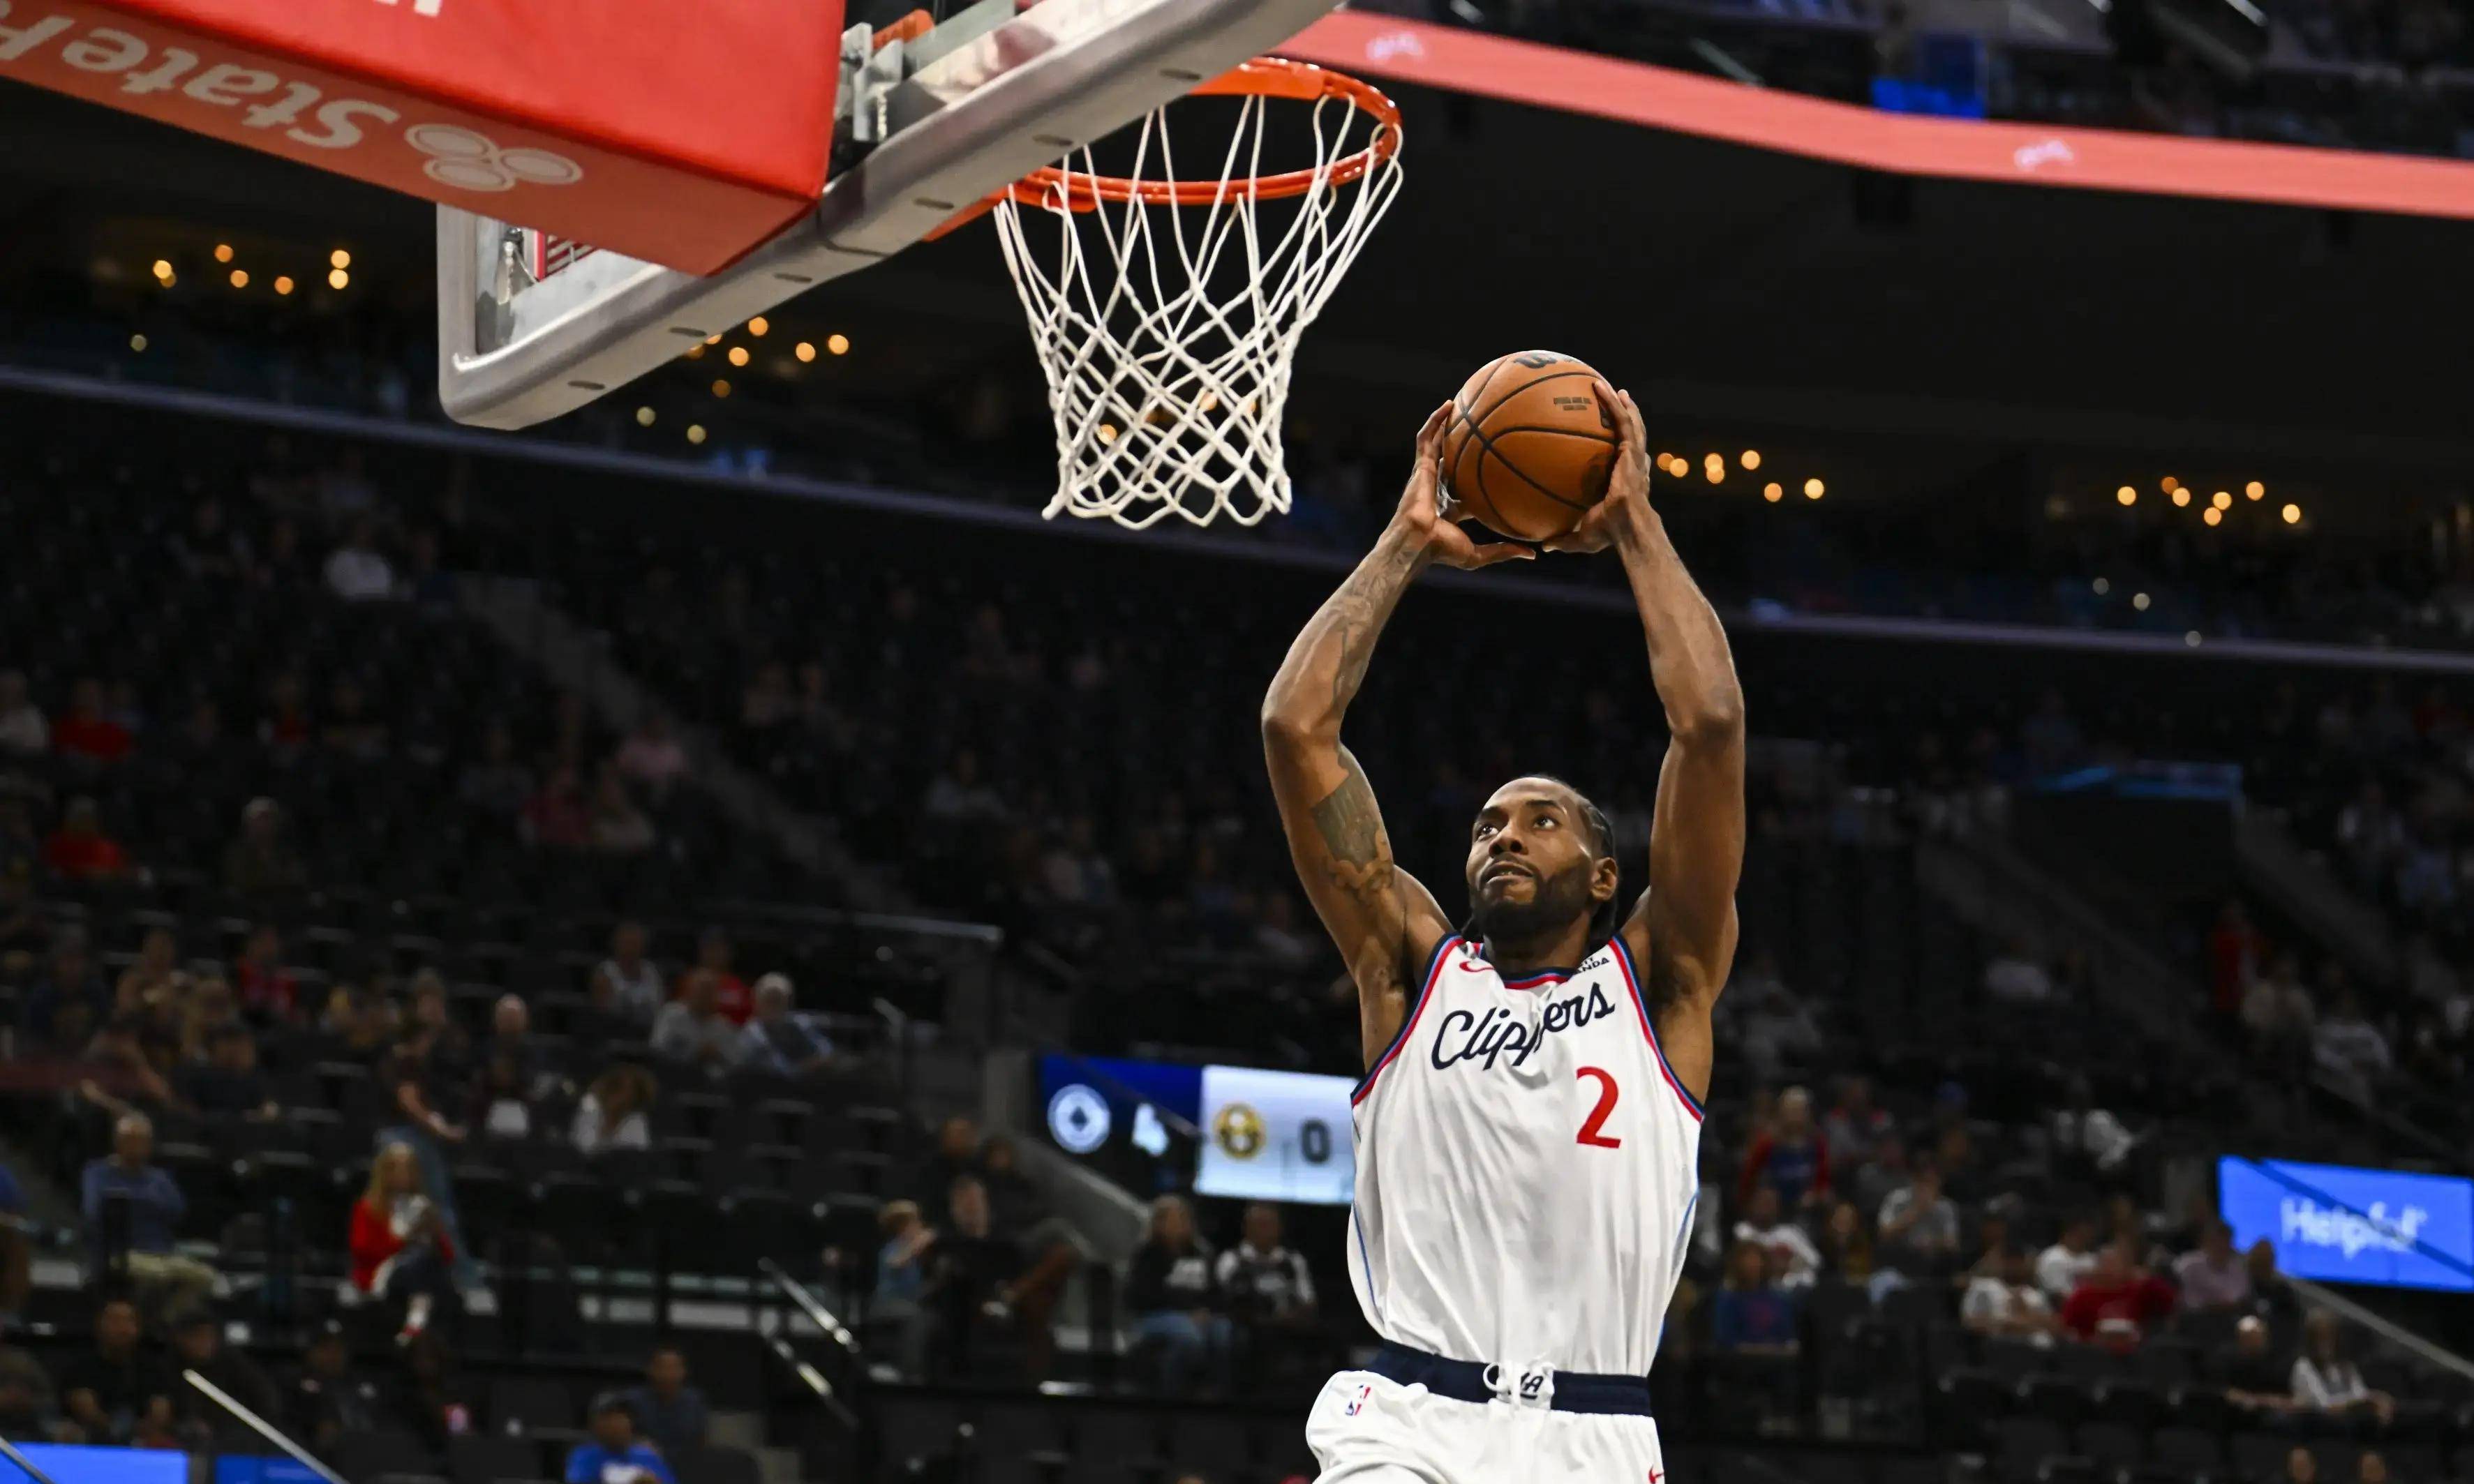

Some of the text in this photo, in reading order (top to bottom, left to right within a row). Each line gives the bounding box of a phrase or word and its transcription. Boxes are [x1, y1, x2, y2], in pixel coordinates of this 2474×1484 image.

[1431, 982, 1616, 1071] Clippers
[1299, 1118, 1332, 1166] 0
[1576, 1066, 1622, 1149] 2
